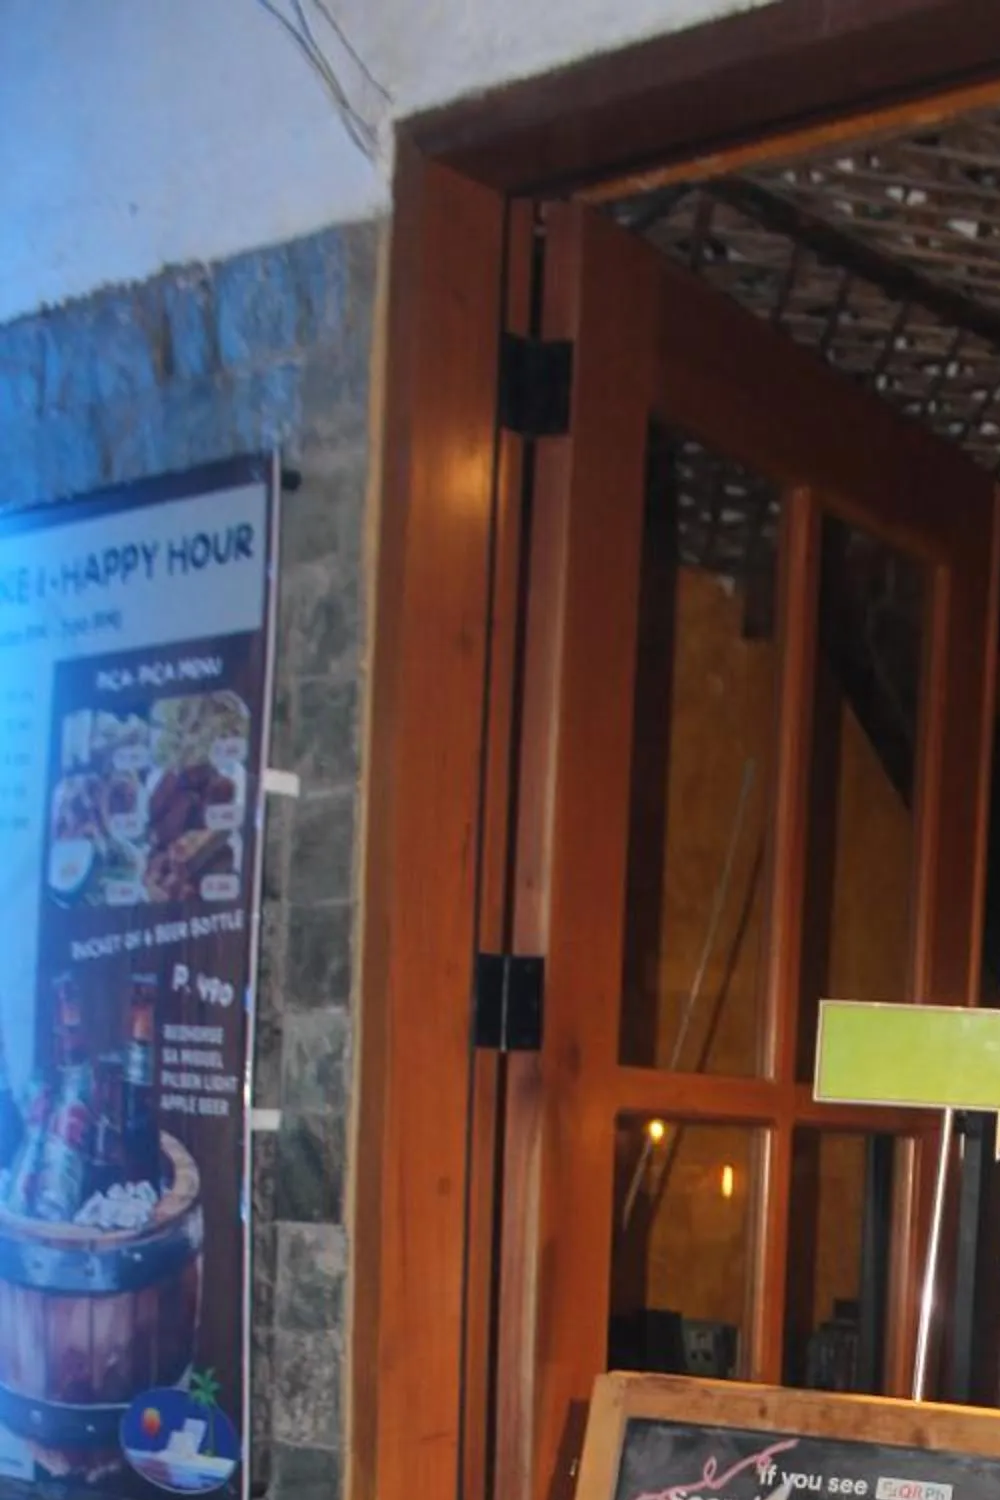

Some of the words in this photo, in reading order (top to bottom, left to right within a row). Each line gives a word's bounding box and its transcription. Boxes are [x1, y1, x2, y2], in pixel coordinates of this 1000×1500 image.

[167, 521, 255, 577] HOUR
[782, 1471, 822, 1496] you
[828, 1477, 868, 1496] see
